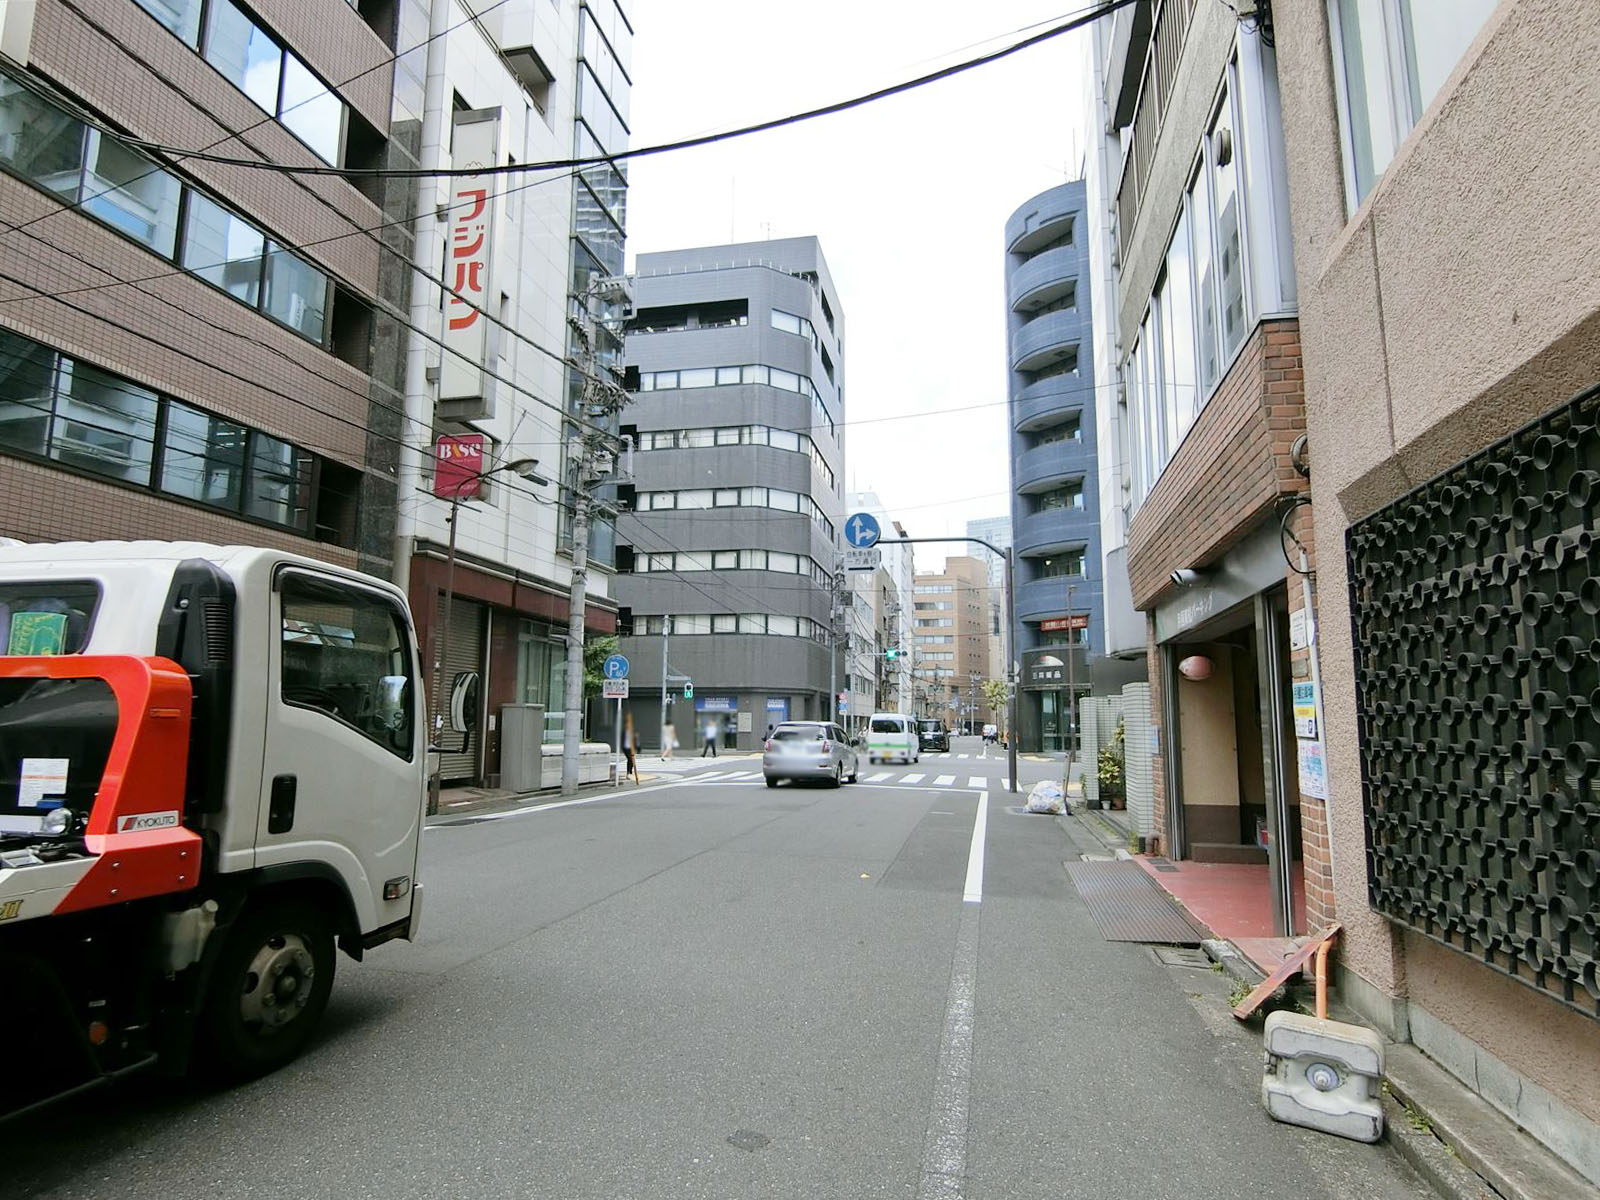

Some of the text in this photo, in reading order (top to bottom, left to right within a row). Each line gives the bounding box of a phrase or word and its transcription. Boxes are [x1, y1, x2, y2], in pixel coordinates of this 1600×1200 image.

[449, 189, 487, 330] フジパン
[137, 815, 176, 829] KYOKUTO
